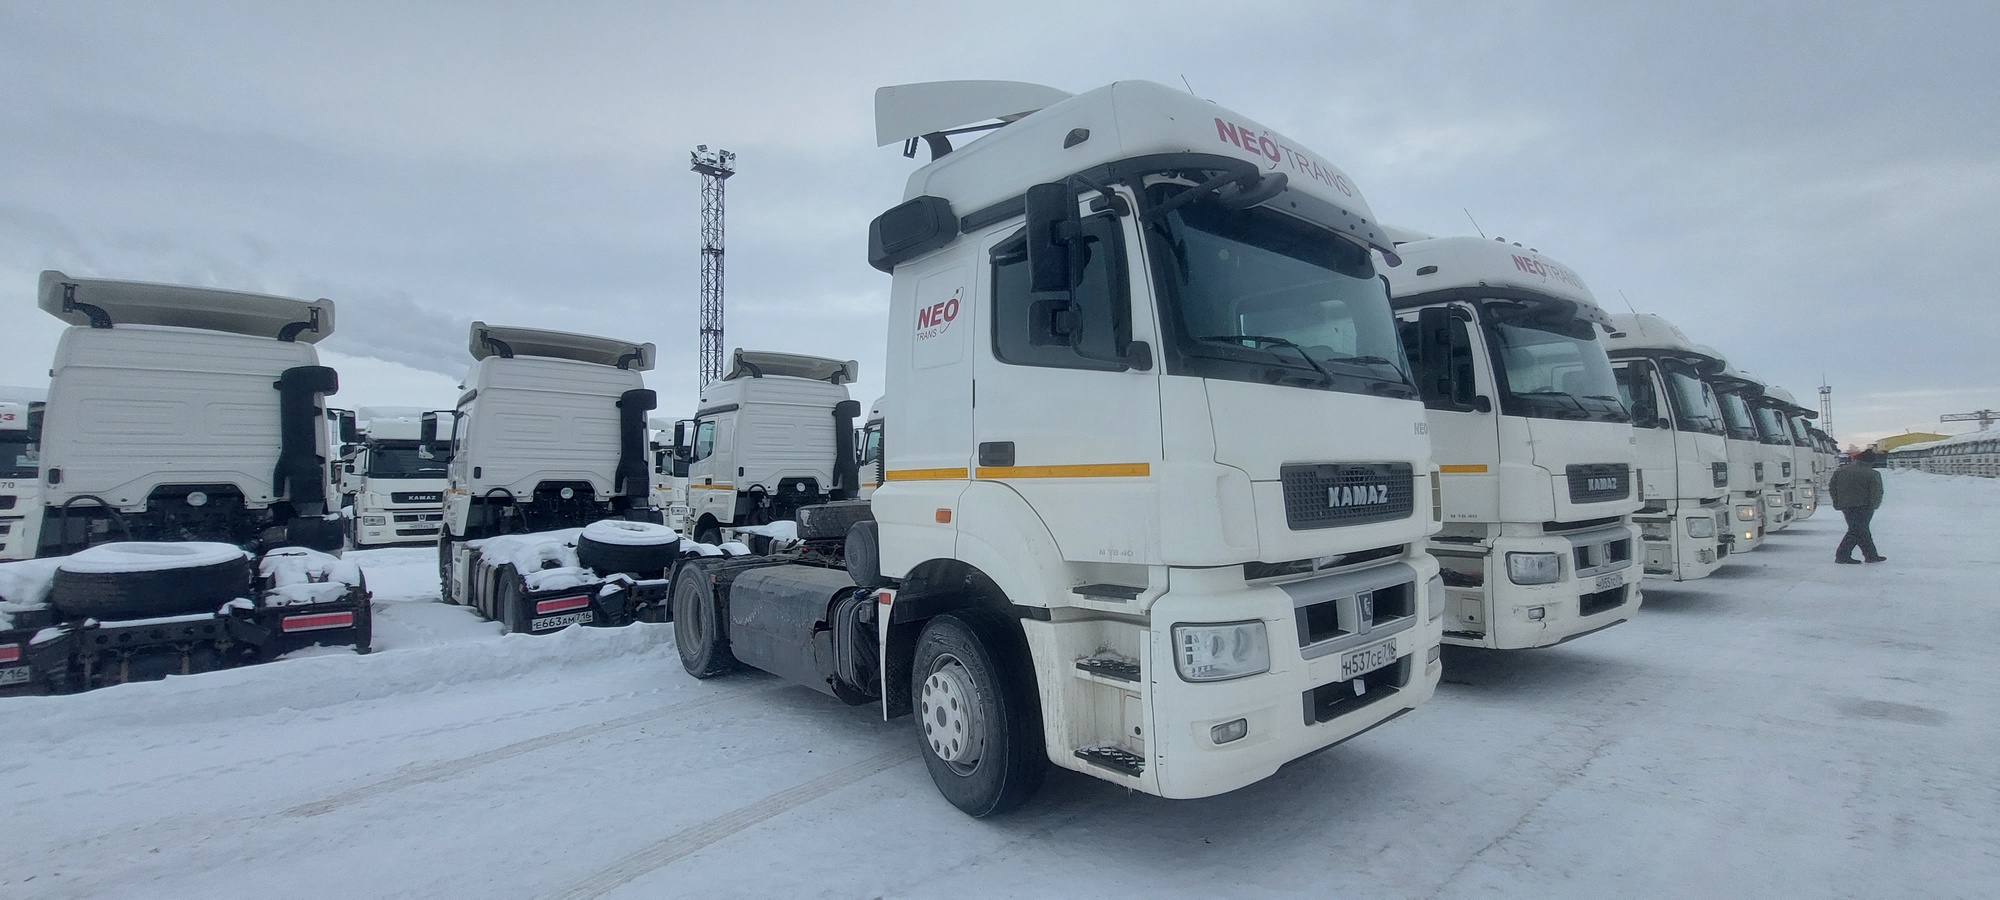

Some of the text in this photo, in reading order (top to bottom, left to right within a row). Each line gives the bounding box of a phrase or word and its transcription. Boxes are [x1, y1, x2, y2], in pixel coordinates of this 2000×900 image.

[1214, 117, 1352, 197] NEO TRANS
[1511, 253, 1547, 277] NEO
[917, 298, 959, 331] NEO
[916, 328, 937, 342] TRANS
[0, 481, 15, 489] 70
[1328, 484, 1388, 508] KAMAZ
[1587, 477, 1617, 491] KAMAZ
